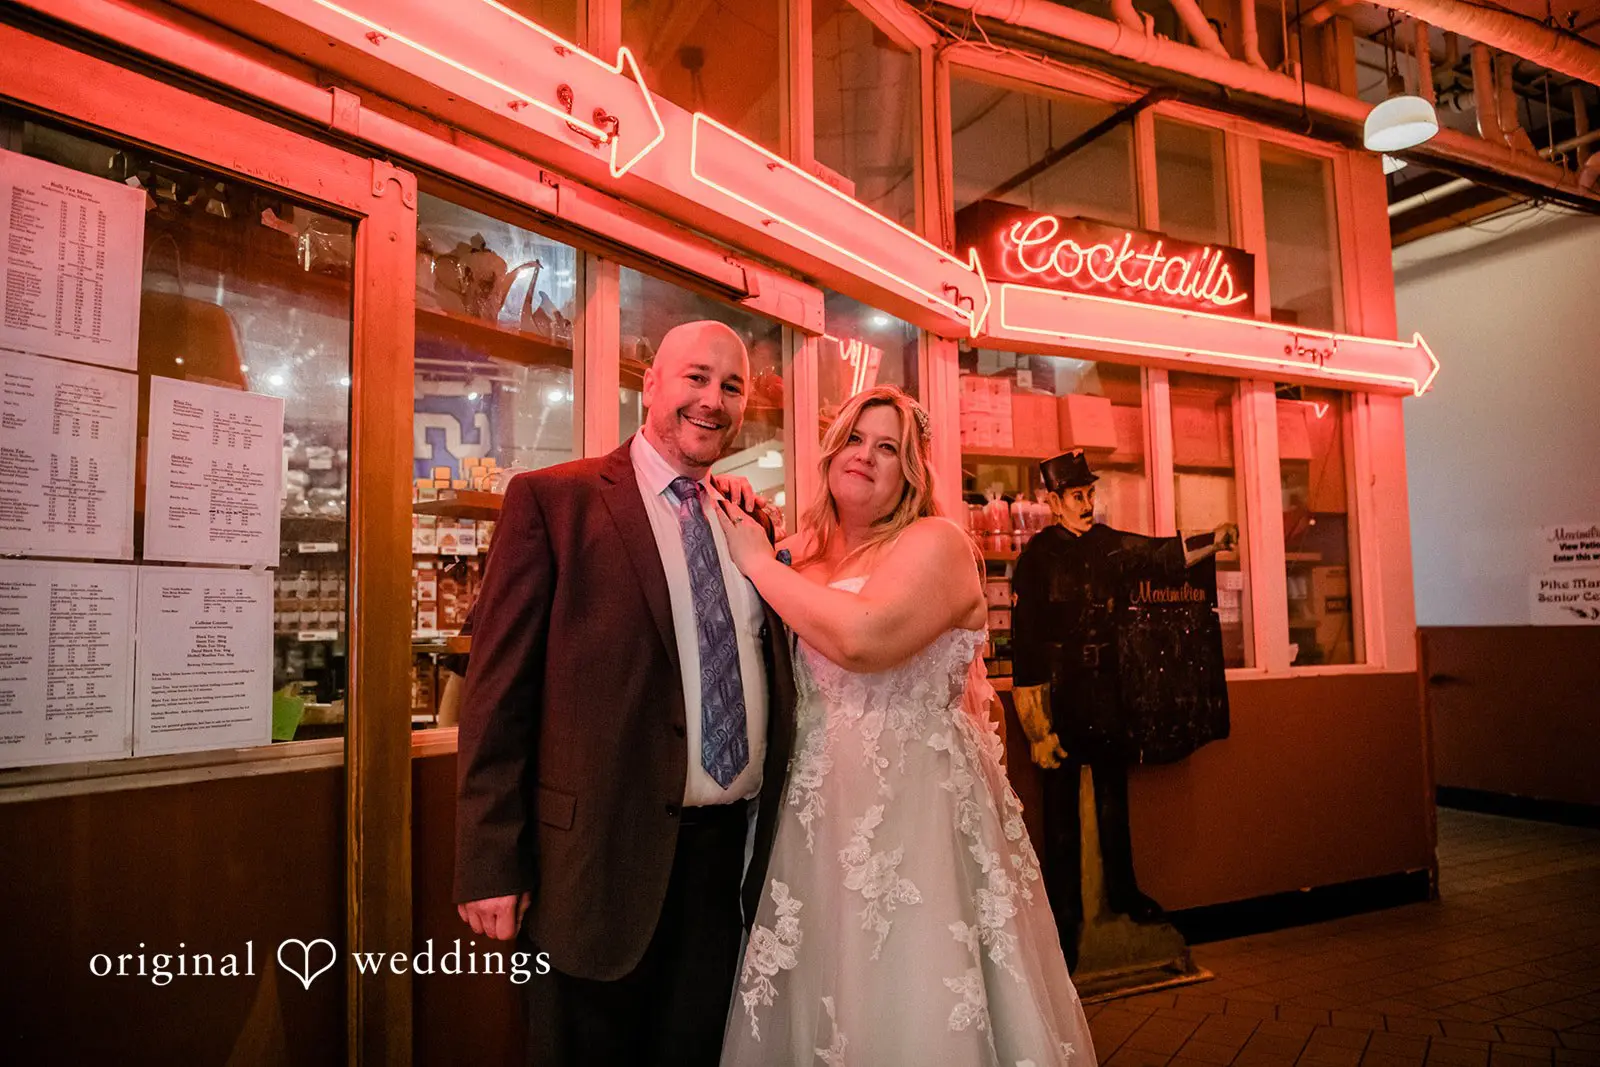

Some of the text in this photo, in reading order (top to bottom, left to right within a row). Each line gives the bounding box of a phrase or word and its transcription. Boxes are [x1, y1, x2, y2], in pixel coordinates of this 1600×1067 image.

[1010, 214, 1248, 305] Cocktails
[1559, 542, 1578, 551] View
[1553, 554, 1574, 562] Enter
[1576, 552, 1591, 561] this
[1540, 579, 1569, 590] Pike
[1538, 592, 1580, 602] Senior
